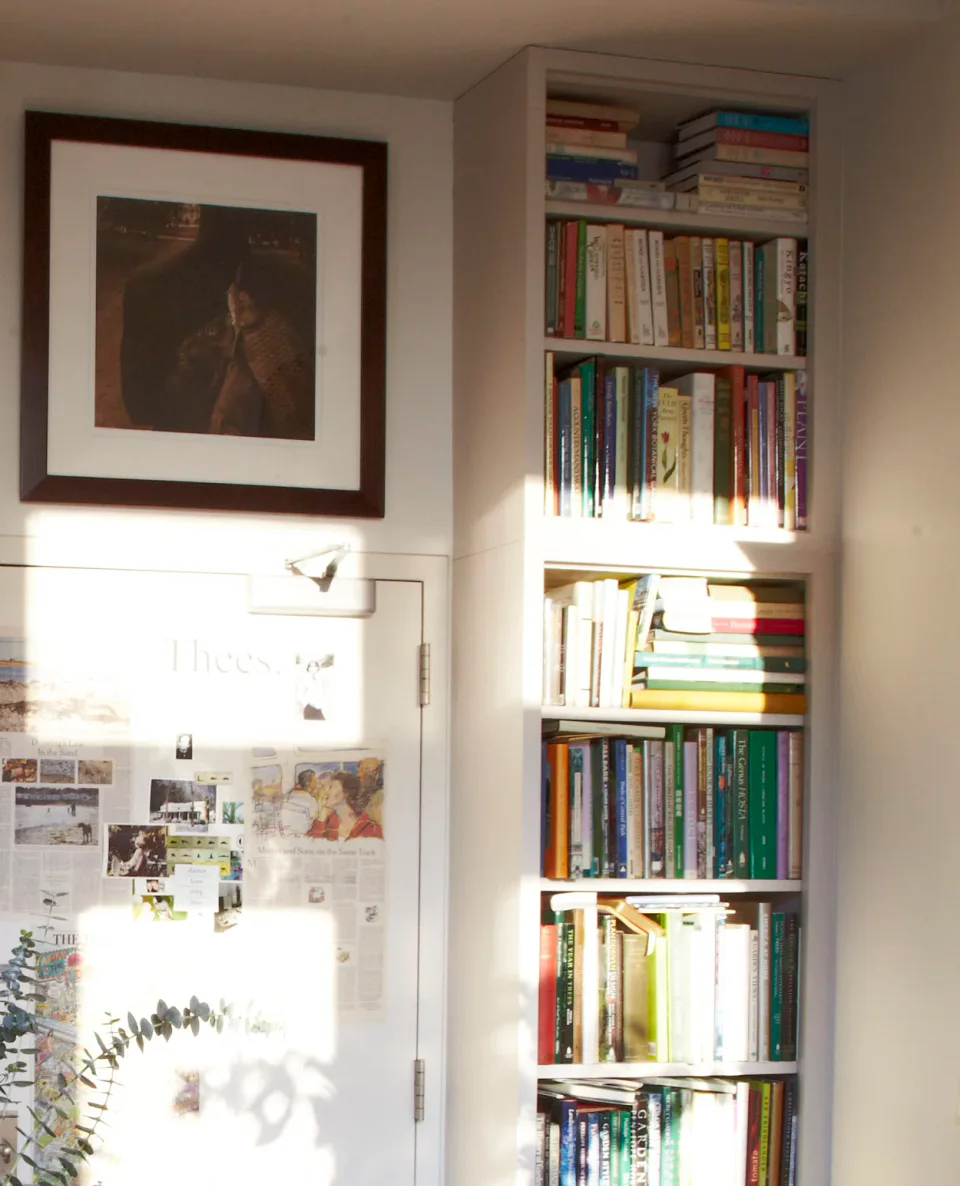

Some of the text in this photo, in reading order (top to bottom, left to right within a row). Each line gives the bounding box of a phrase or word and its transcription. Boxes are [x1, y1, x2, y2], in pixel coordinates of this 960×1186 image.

[785, 250, 795, 295] Kingyo
[796, 401, 807, 461] PLANT
[650, 434, 658, 478] BOTANICAL
[59, 749, 77, 757] Sand
[737, 739, 746, 820] The Genus HOSTA
[53, 934, 78, 945] THE
[760, 1115, 768, 1172] FRIEDLANDER
